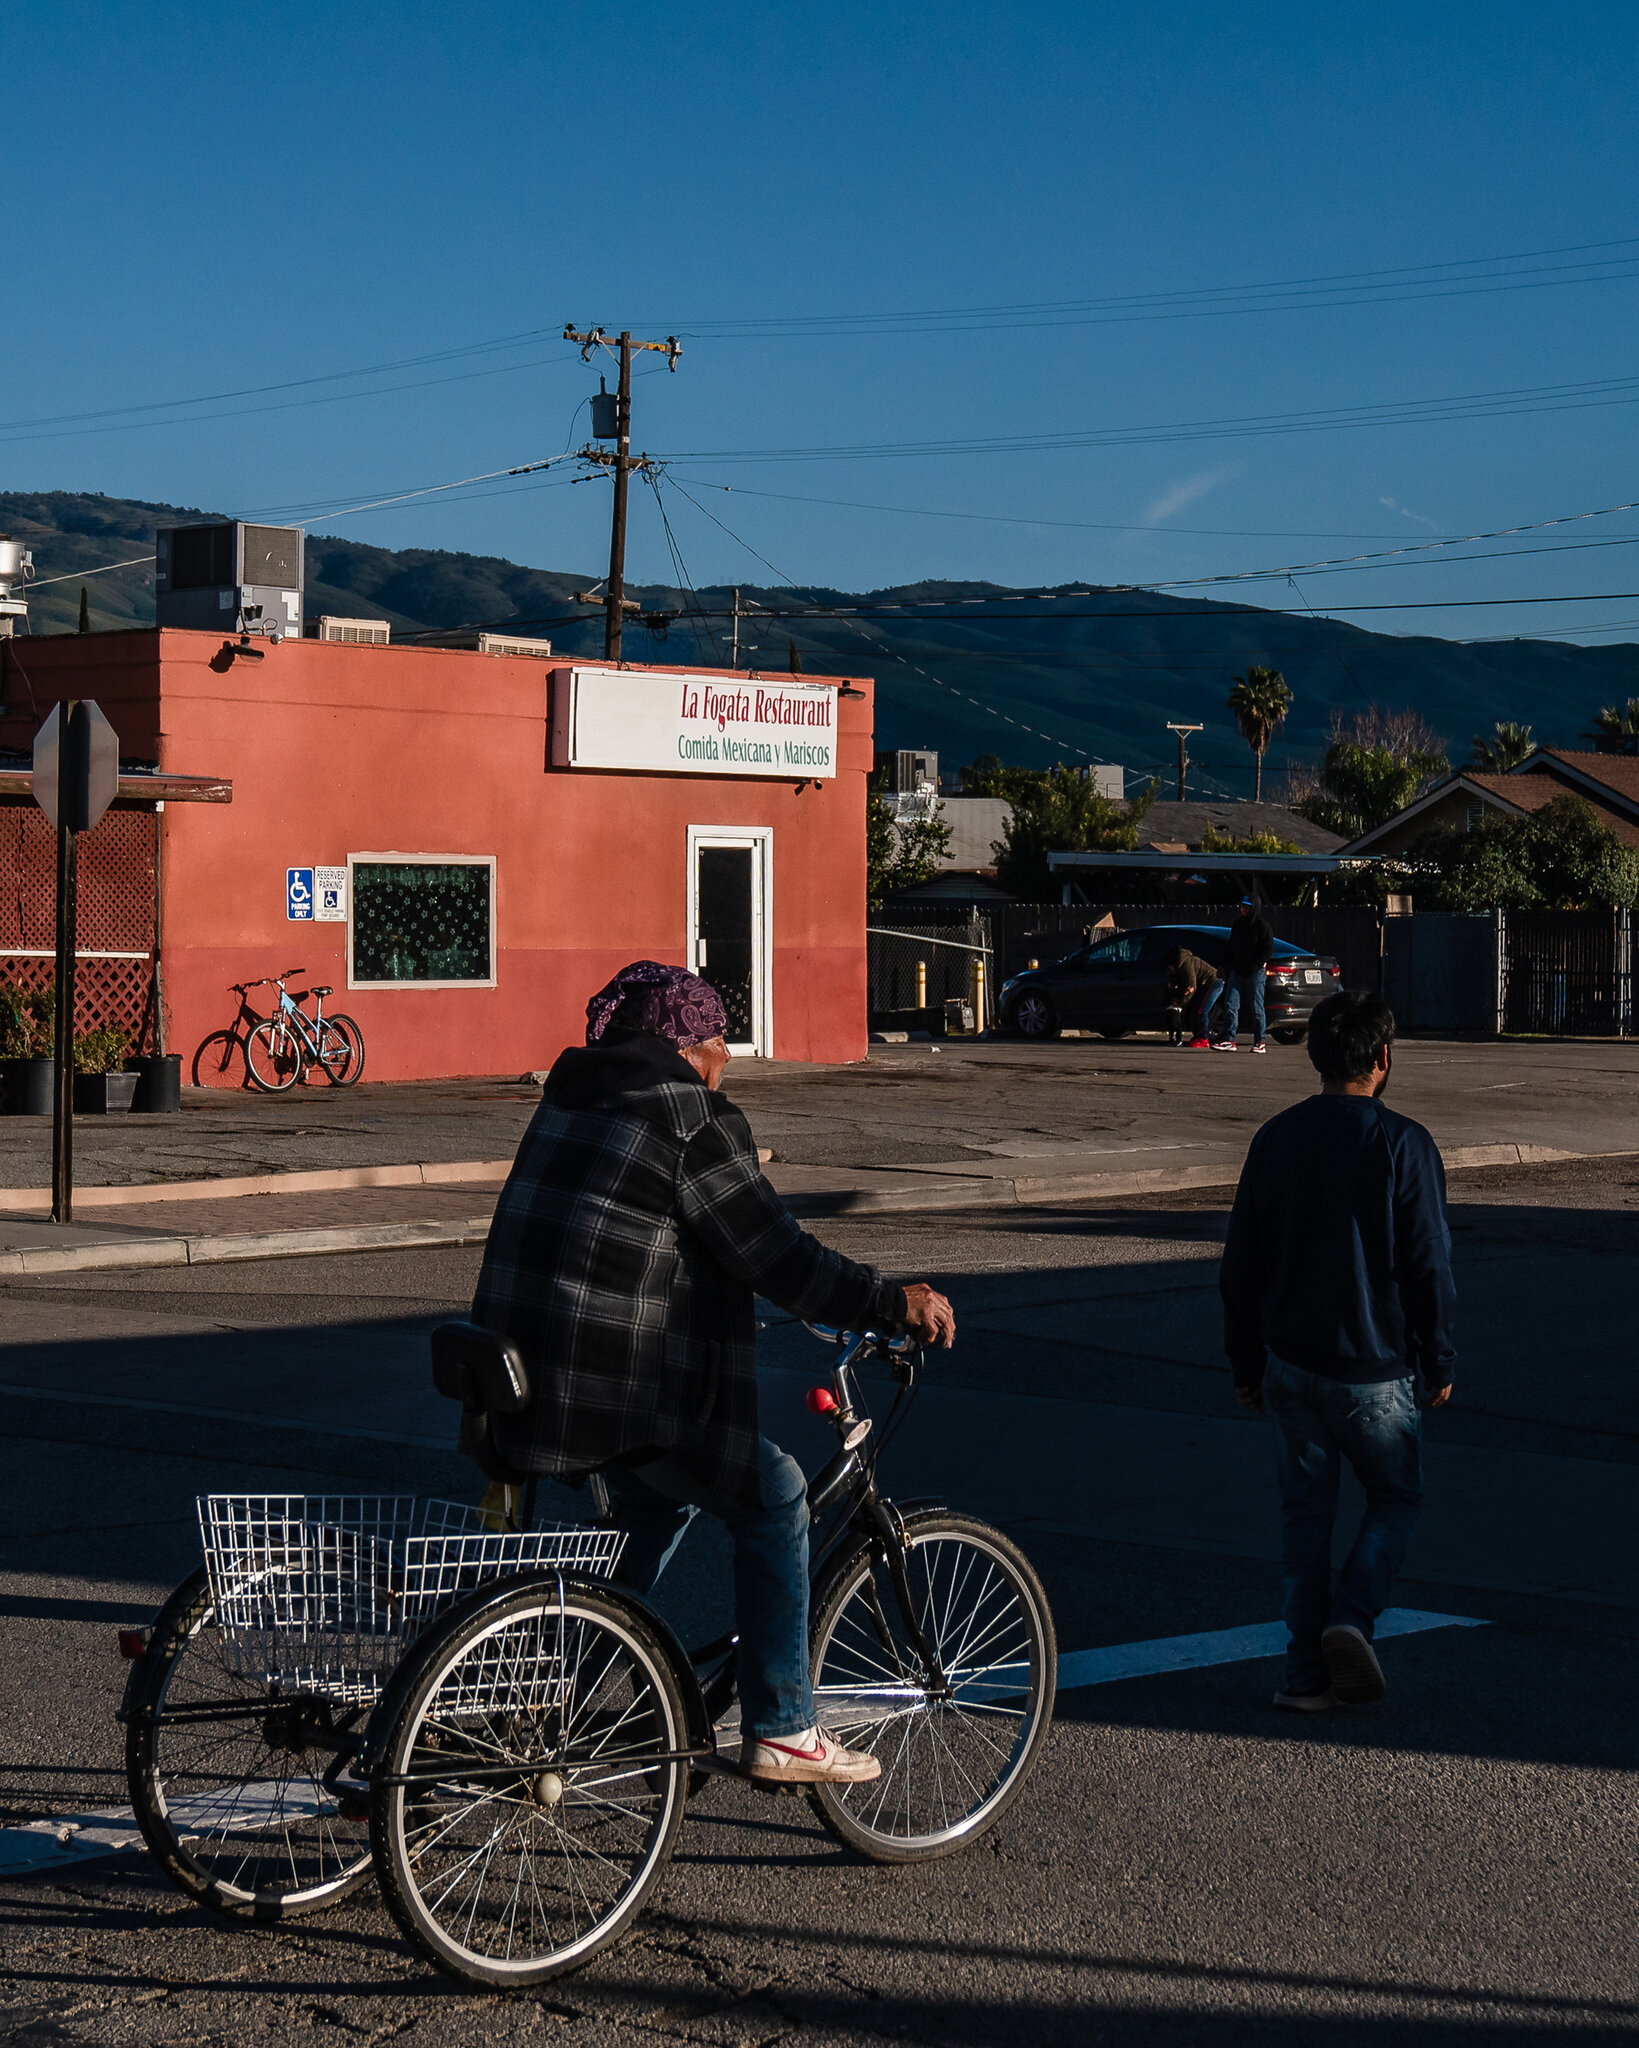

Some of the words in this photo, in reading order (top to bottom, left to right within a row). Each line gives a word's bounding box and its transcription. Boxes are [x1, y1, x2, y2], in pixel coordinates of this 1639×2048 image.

[681, 684, 698, 719] La
[703, 685, 750, 732] Fogata
[754, 689, 832, 727] Restaurant
[678, 734, 719, 760] Comida
[722, 737, 772, 763] Mexicana
[774, 743, 781, 768] y
[784, 740, 830, 766] Mariscos
[317, 870, 345, 880] RESERVED
[319, 880, 342, 890] PARKING
